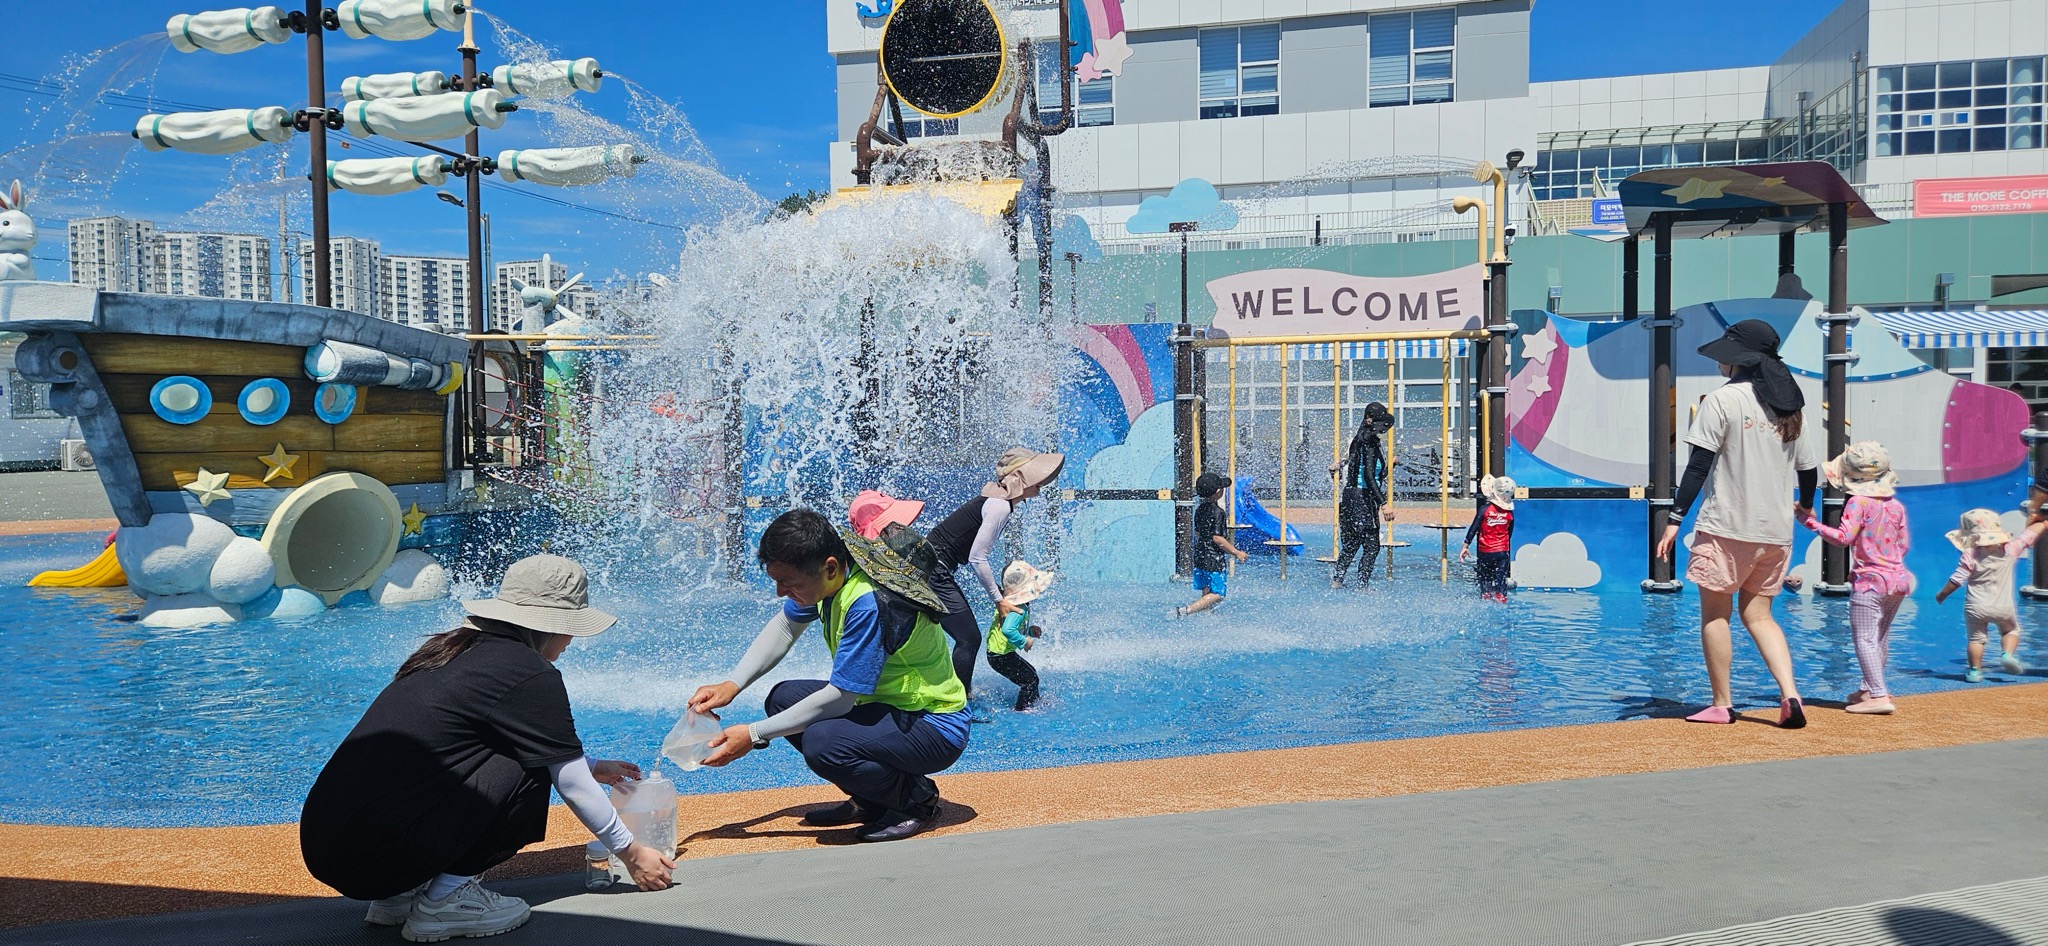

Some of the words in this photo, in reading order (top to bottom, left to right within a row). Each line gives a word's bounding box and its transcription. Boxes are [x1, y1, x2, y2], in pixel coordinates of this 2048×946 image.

[1941, 192, 1964, 203] THE
[1968, 190, 2006, 202] MORE
[2008, 188, 2048, 200] COFF
[1970, 202, 2032, 212] 010.3122.7176
[1231, 286, 1461, 321] WELCOME
